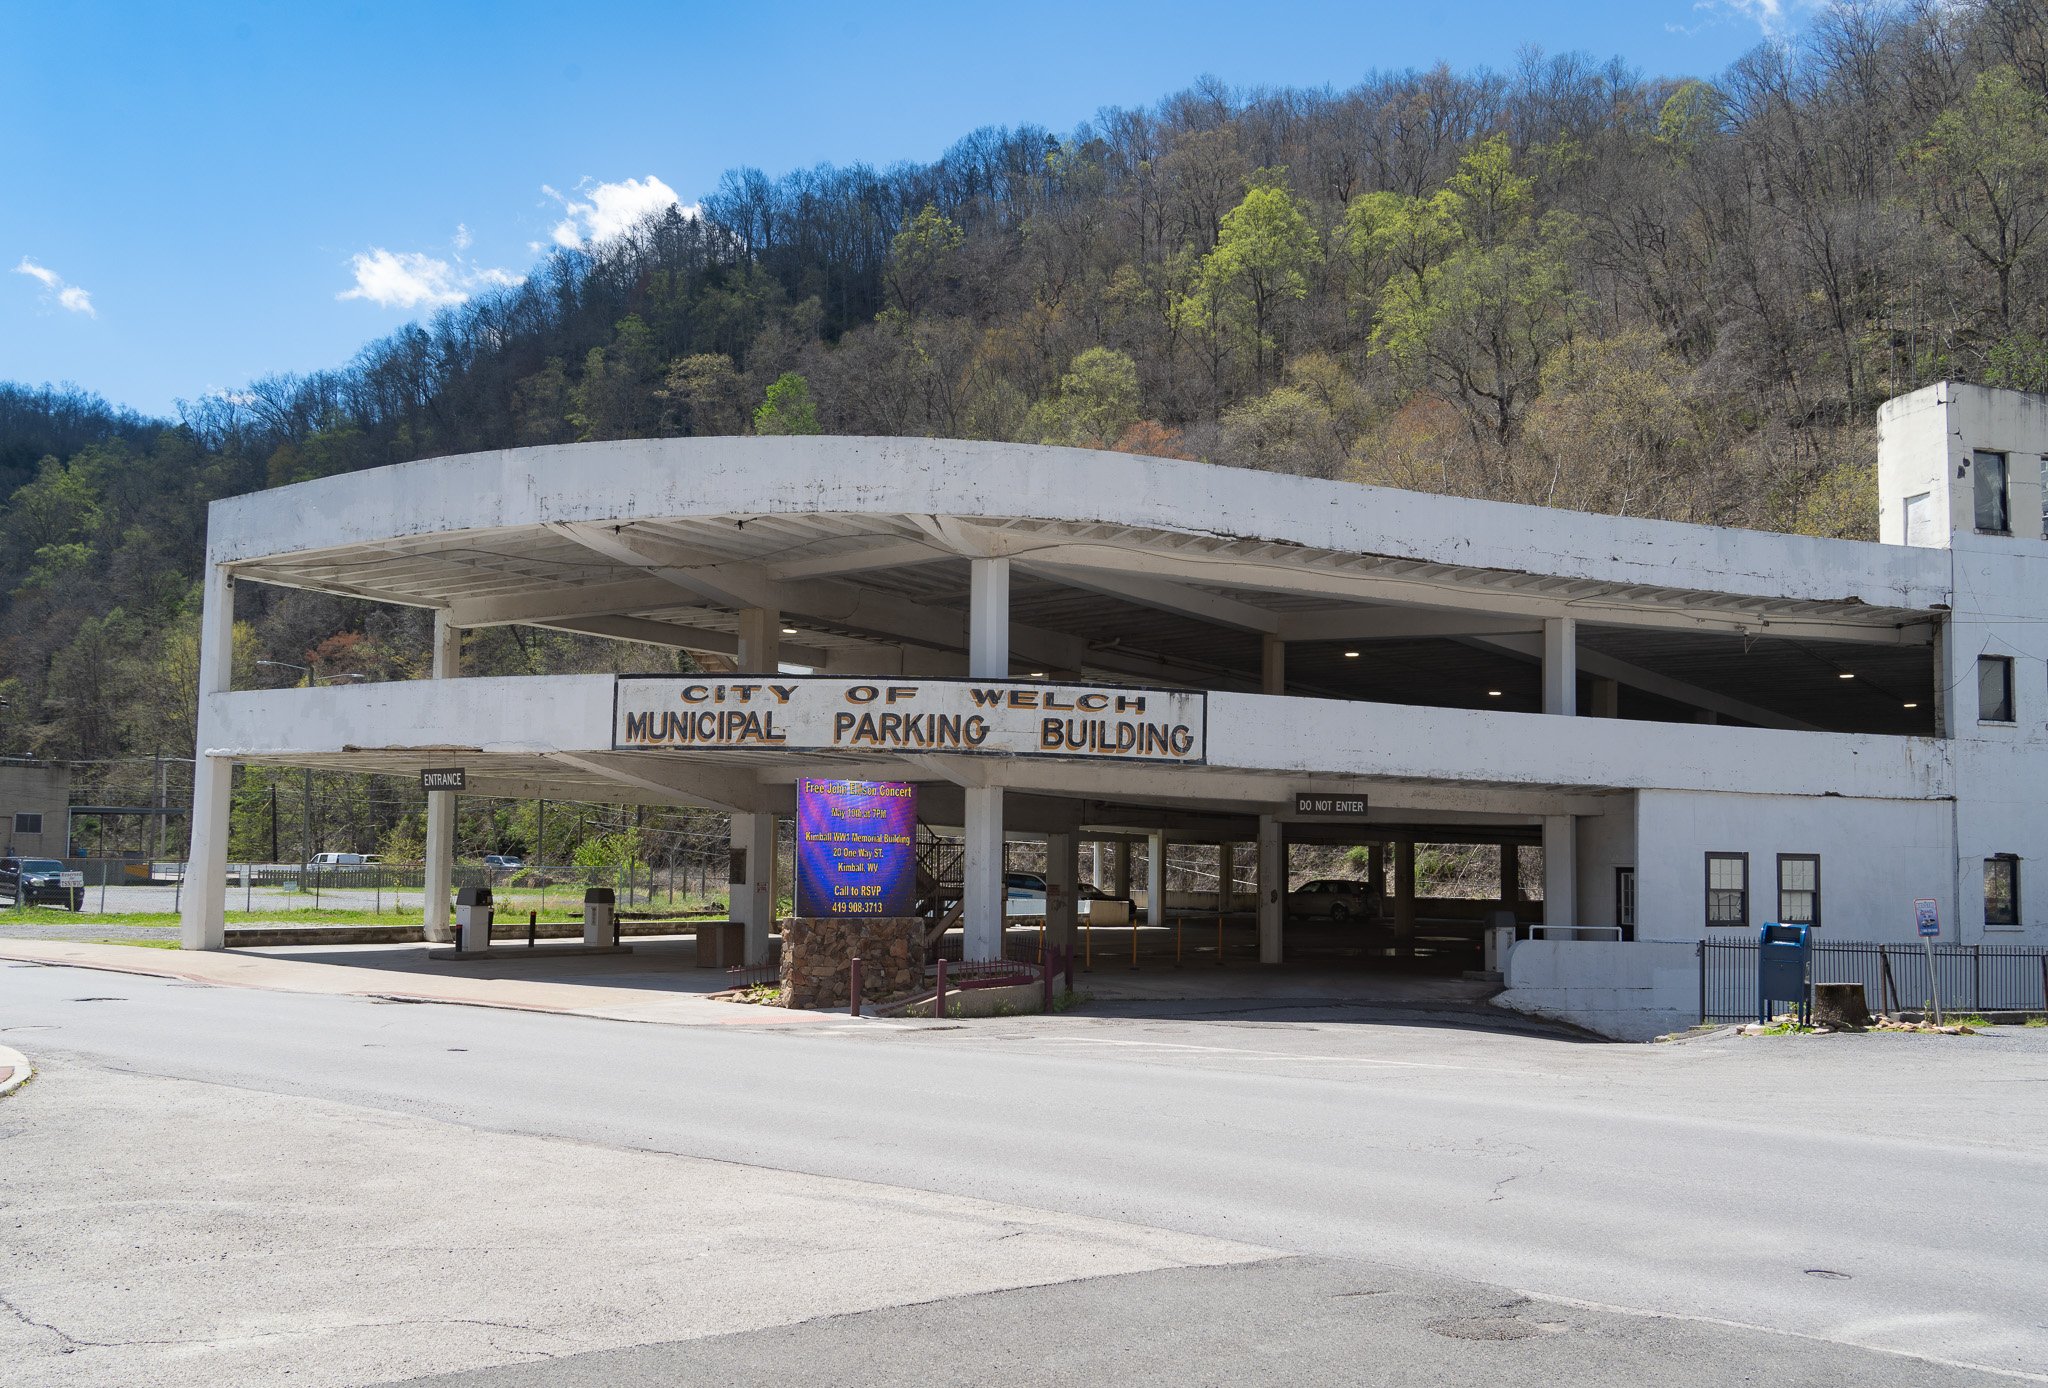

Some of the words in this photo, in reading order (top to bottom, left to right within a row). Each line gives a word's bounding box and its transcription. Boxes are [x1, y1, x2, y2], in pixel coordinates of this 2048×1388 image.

[681, 684, 799, 705] CITY
[845, 685, 919, 705] OF
[969, 688, 1146, 714] WELCH
[626, 711, 787, 744] MUNICIPAL
[834, 711, 990, 748] PARKING
[1040, 717, 1194, 757] BUILDING
[424, 773, 462, 786] ENTRANCE
[805, 781, 825, 794] Free
[827, 782, 847, 796] John
[879, 784, 912, 798] Concert
[1300, 800, 1312, 811] DO
[1315, 800, 1332, 811] NOT
[1336, 801, 1364, 812] ENTER
[831, 807, 845, 819] May
[805, 832, 832, 842] Kimball
[852, 833, 883, 843] Memorial
[883, 834, 911, 846] Building
[833, 847, 842, 857] 20
[843, 847, 857, 858] One
[858, 848, 873, 860] Way
[873, 849, 884, 858] ST.
[867, 863, 878, 873] WV
[834, 885, 849, 896] Call
[851, 886, 859, 896] to
[861, 885, 882, 896] RSVP
[832, 902, 847, 913] 419
[848, 902, 883, 913] 908-3713
